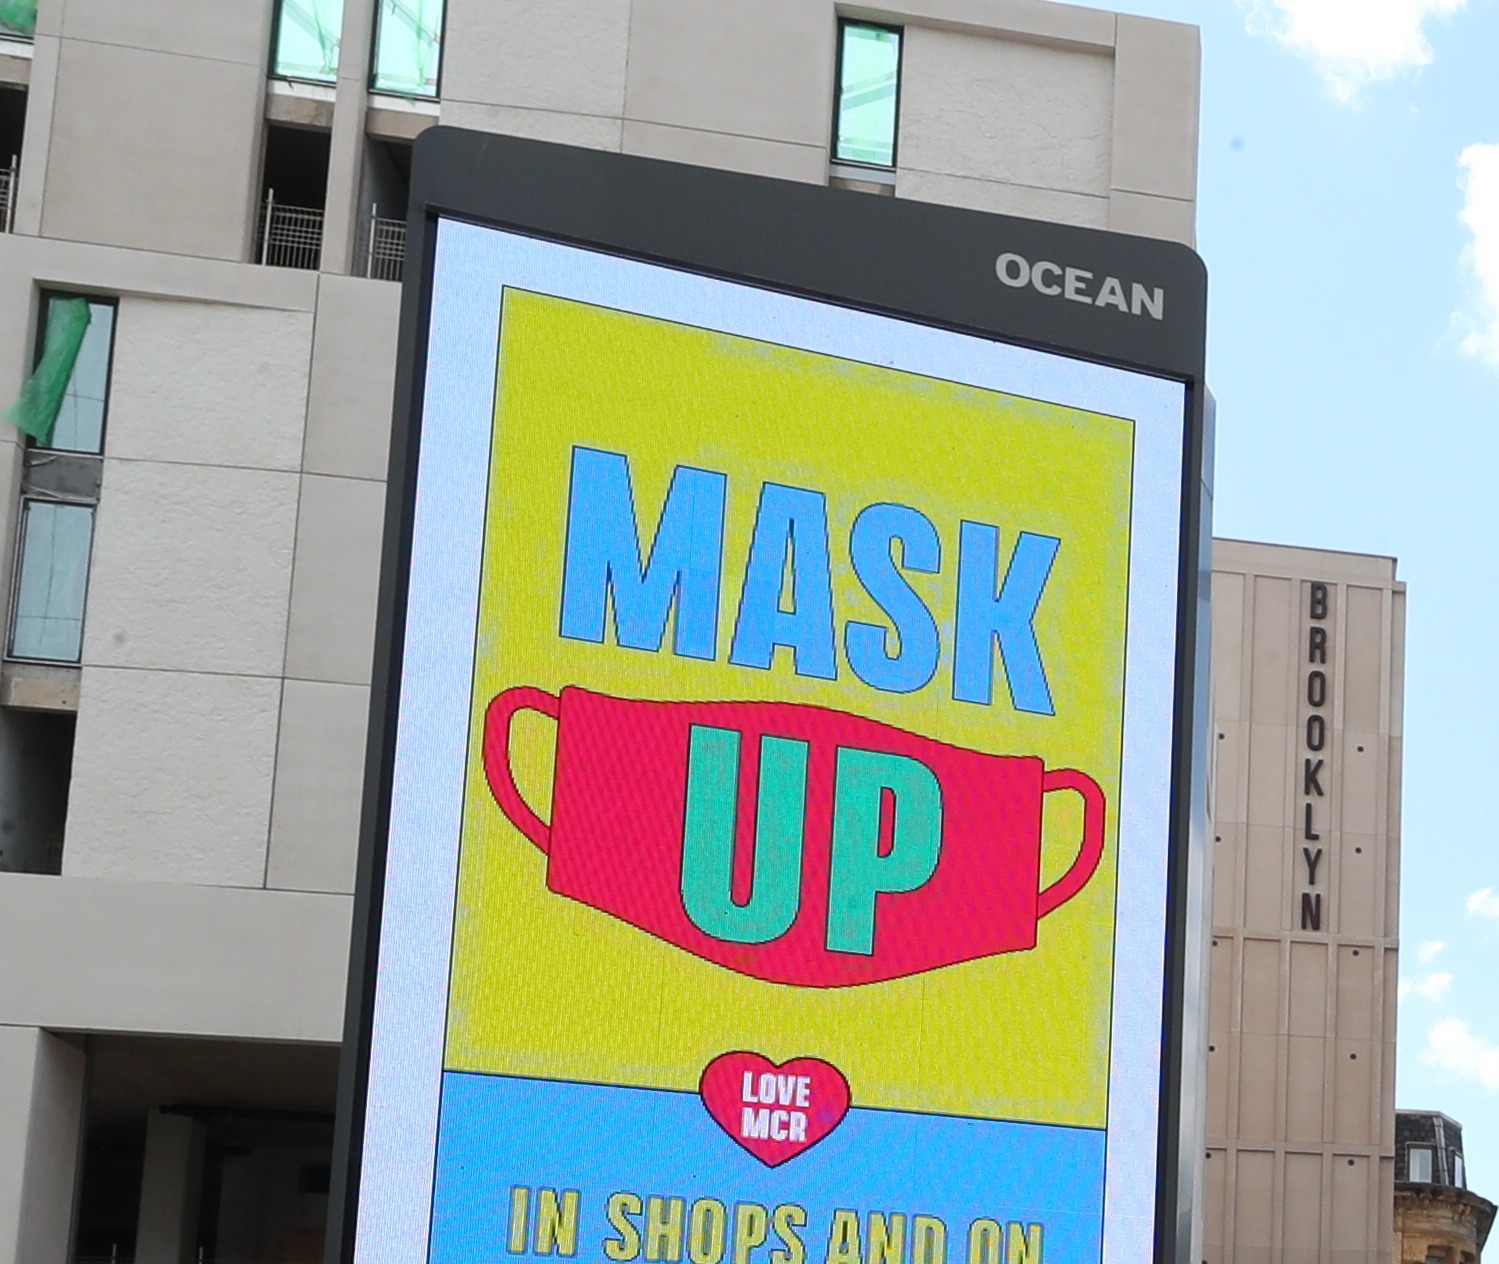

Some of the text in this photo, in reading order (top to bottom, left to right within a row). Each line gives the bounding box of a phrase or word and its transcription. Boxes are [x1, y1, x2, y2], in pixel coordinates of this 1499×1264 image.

[995, 252, 1164, 320] OCEAN
[558, 445, 1061, 716] MASK
[1301, 581, 1328, 931] BROOKLYN
[680, 723, 943, 957] UP
[741, 1108, 808, 1142] MCR
[742, 1072, 811, 1107] LOVE
[508, 1186, 579, 1257] IN
